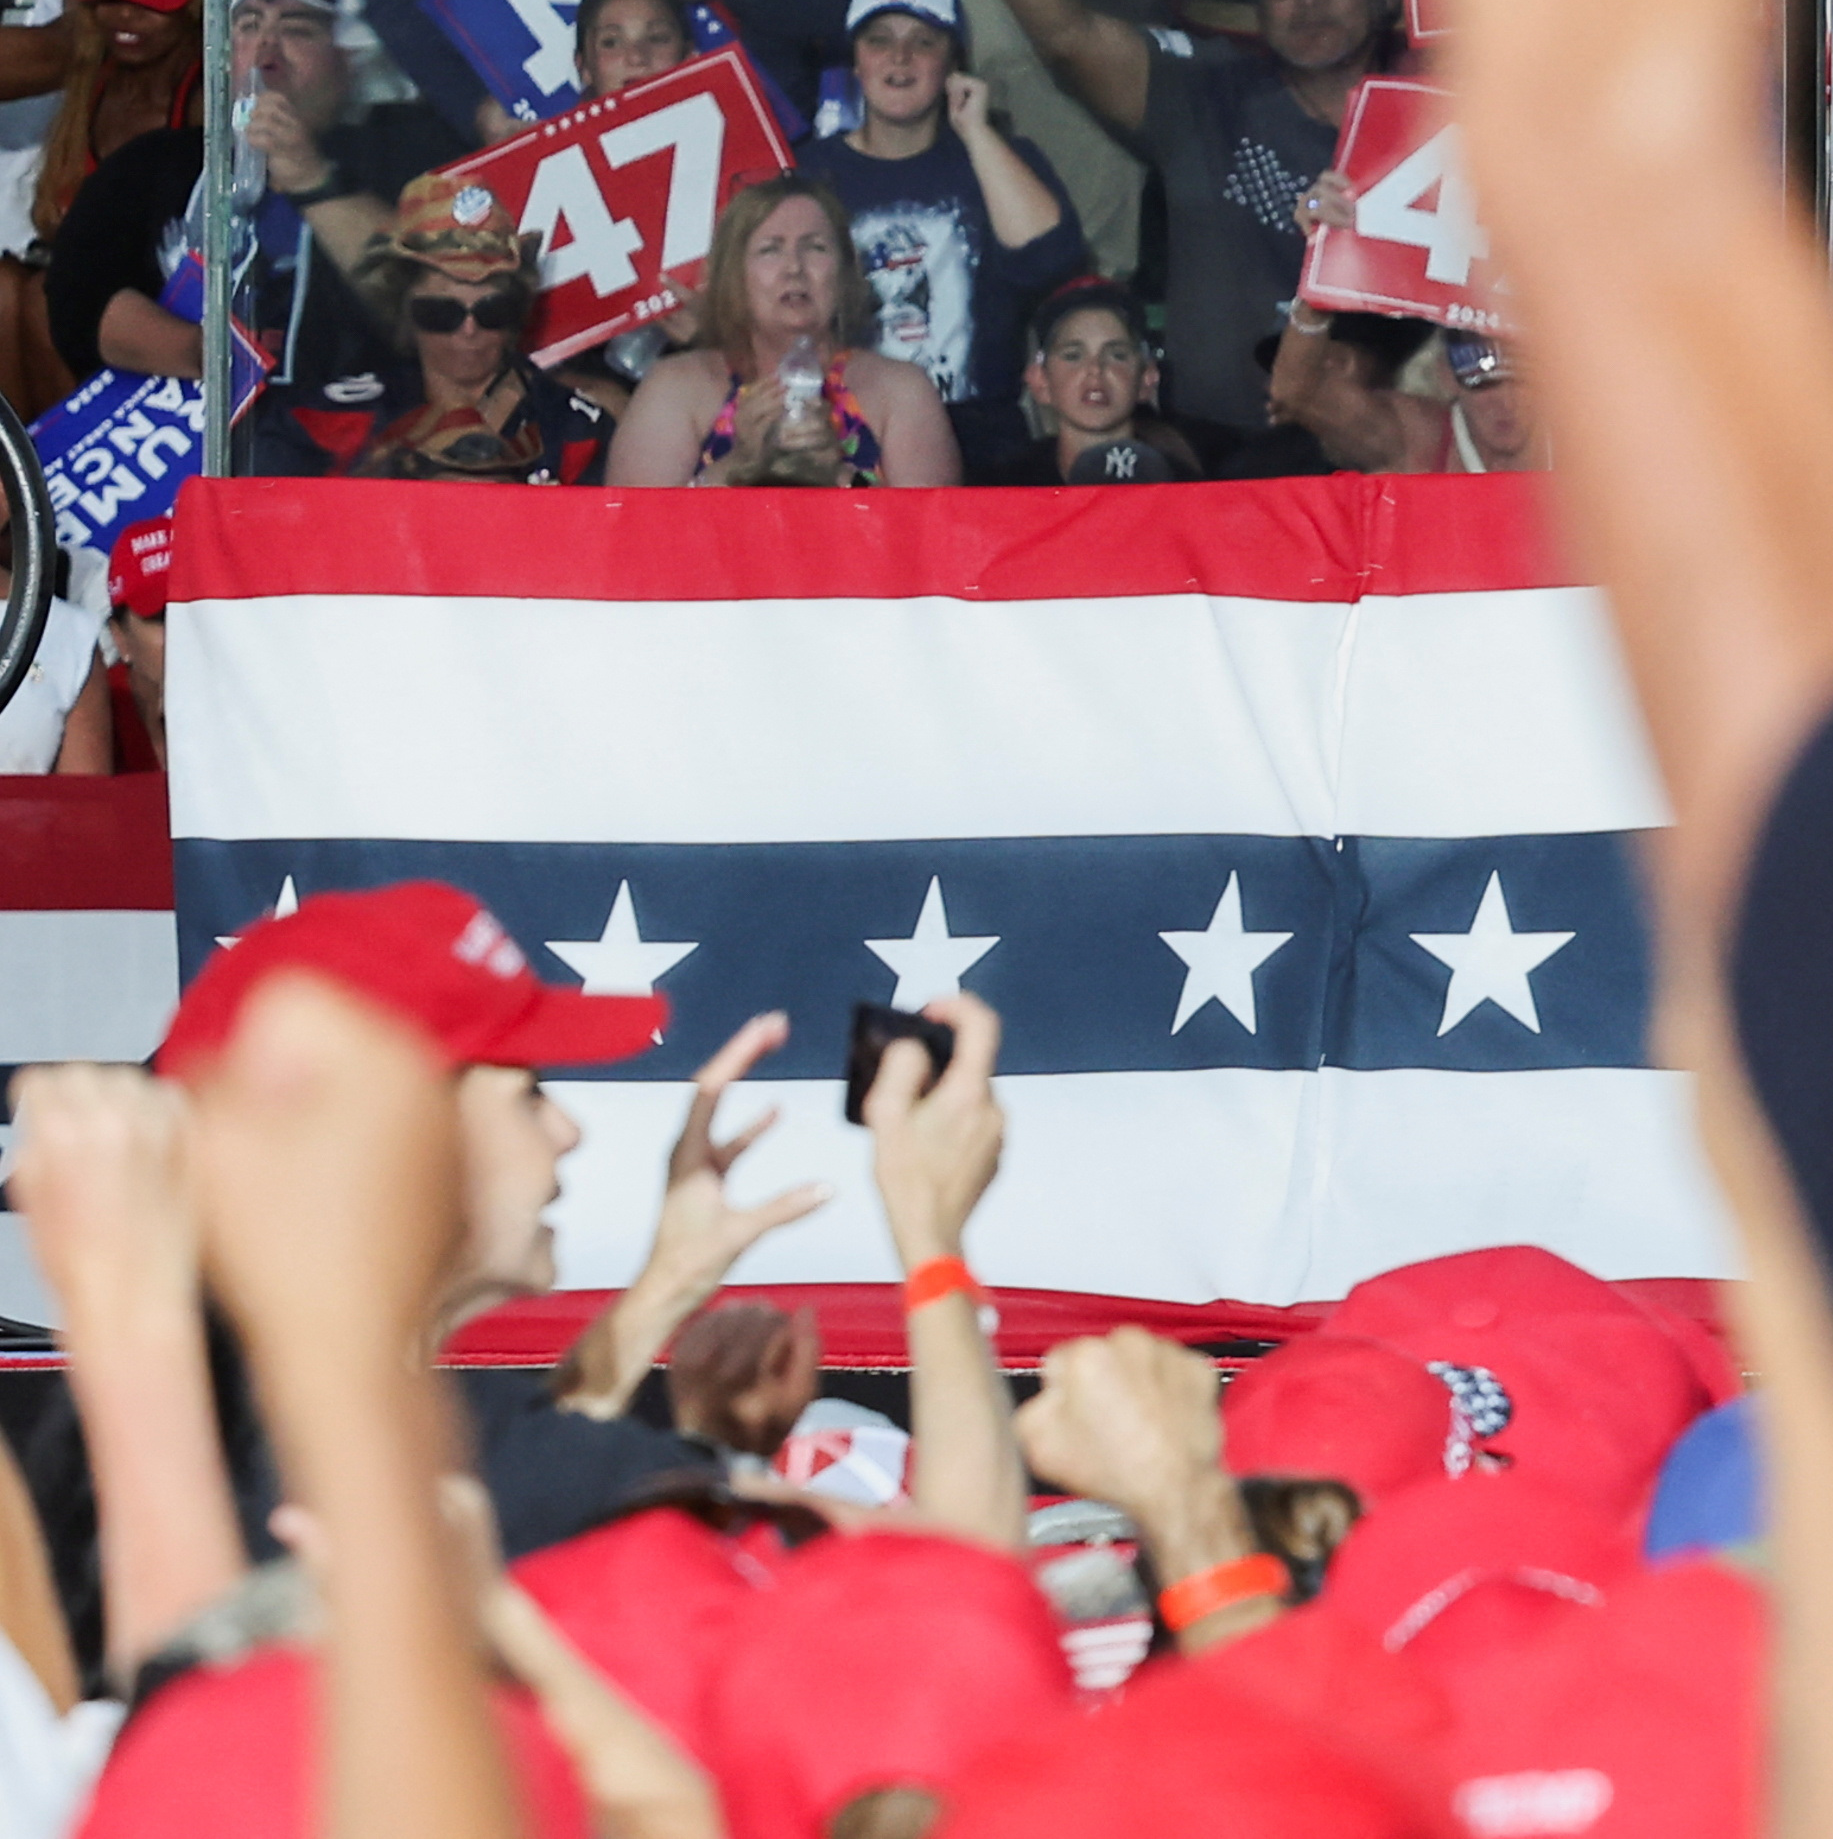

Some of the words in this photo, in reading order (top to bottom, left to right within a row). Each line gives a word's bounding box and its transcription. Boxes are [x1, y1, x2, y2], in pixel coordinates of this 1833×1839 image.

[517, 92, 726, 299] 47
[1355, 123, 1490, 286] 4
[1447, 303, 1500, 329] 2024
[47, 376, 184, 512] ANCE
[140, 550, 173, 577] GREA
